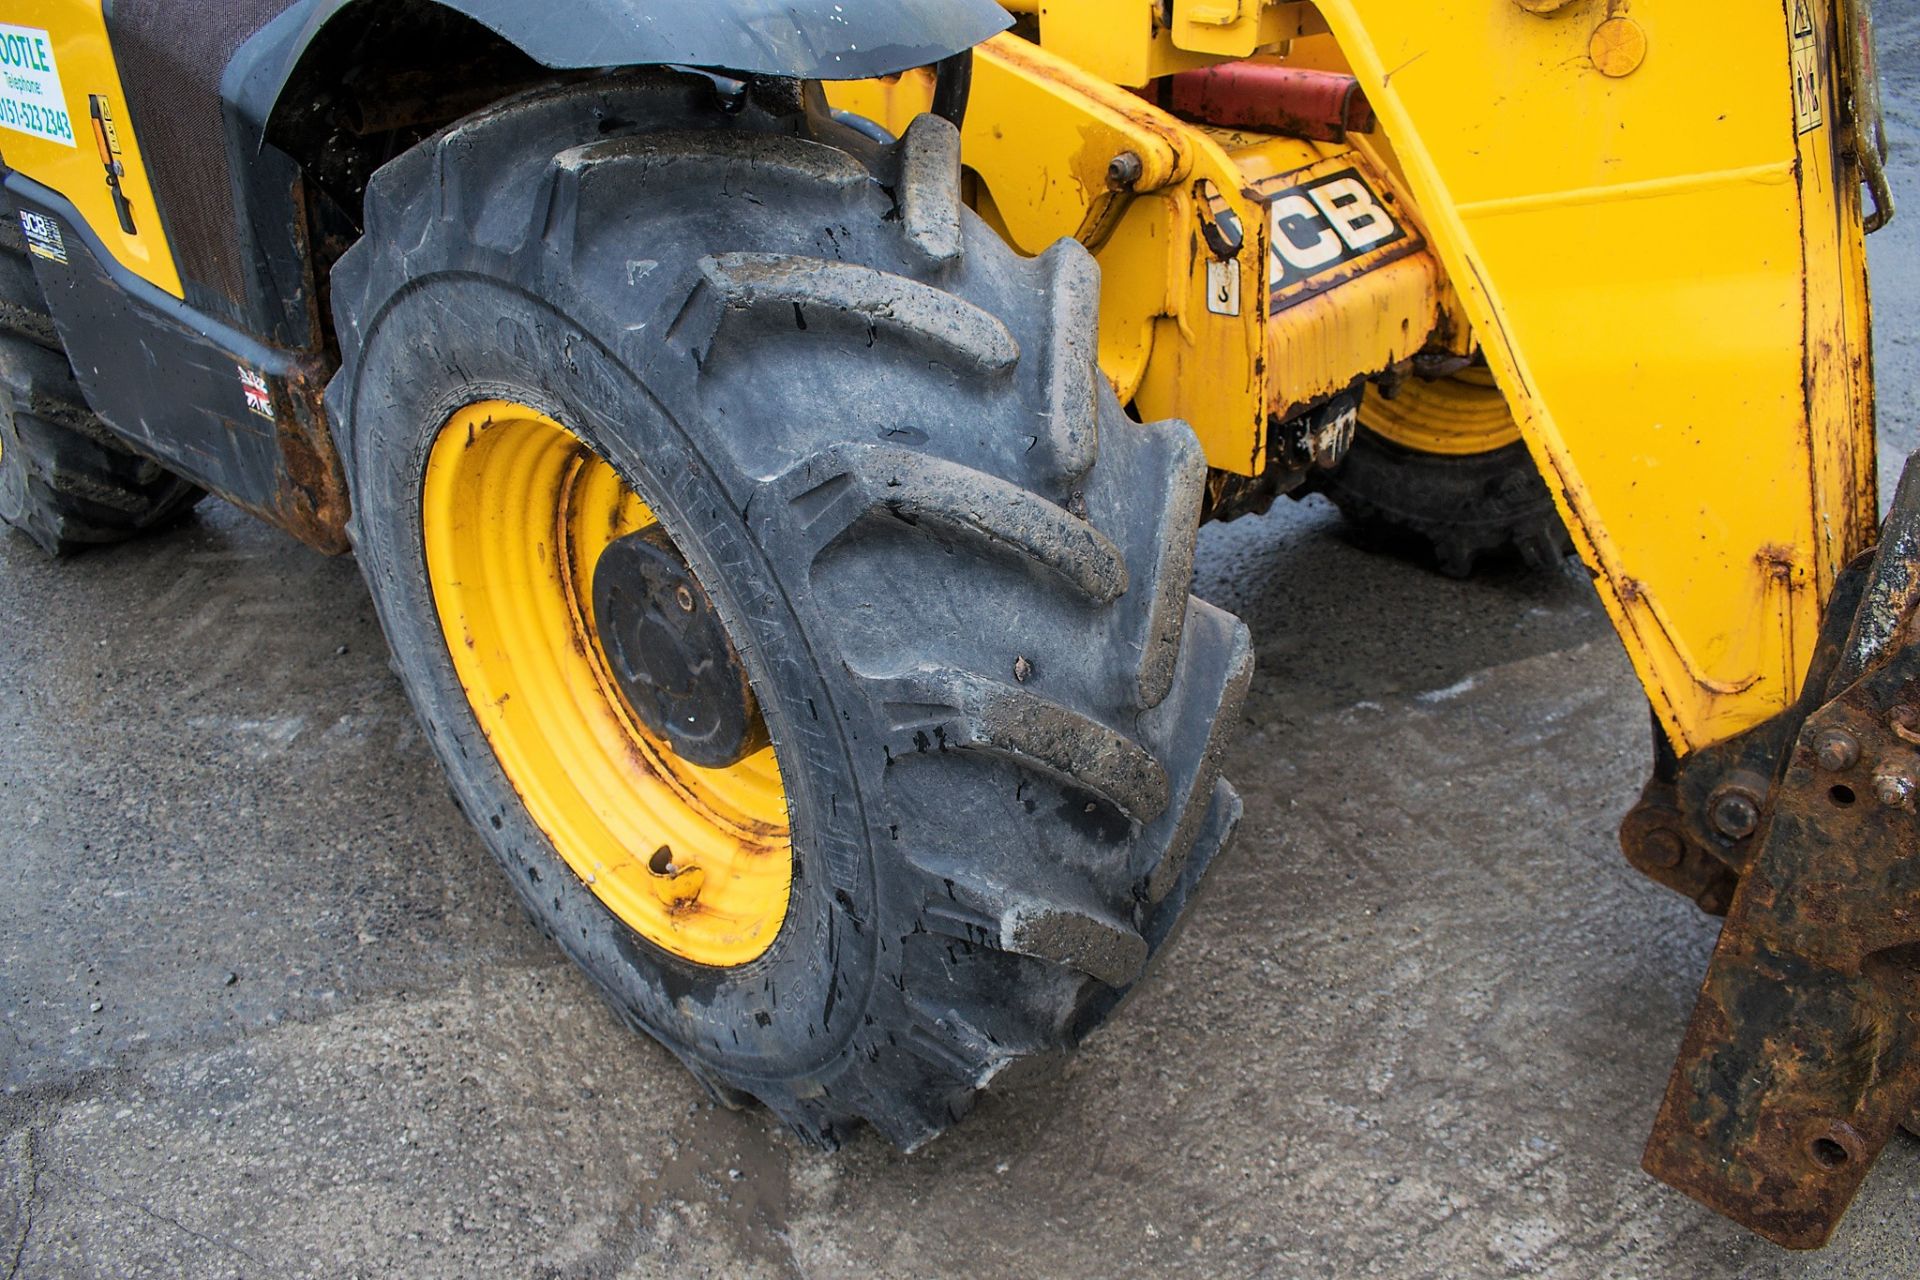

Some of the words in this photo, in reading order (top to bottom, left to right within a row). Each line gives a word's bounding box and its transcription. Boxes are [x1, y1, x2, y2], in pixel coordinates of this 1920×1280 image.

[42, 107, 72, 139] 2343
[20, 210, 48, 237] JCB
[1270, 178, 1394, 284] CB
